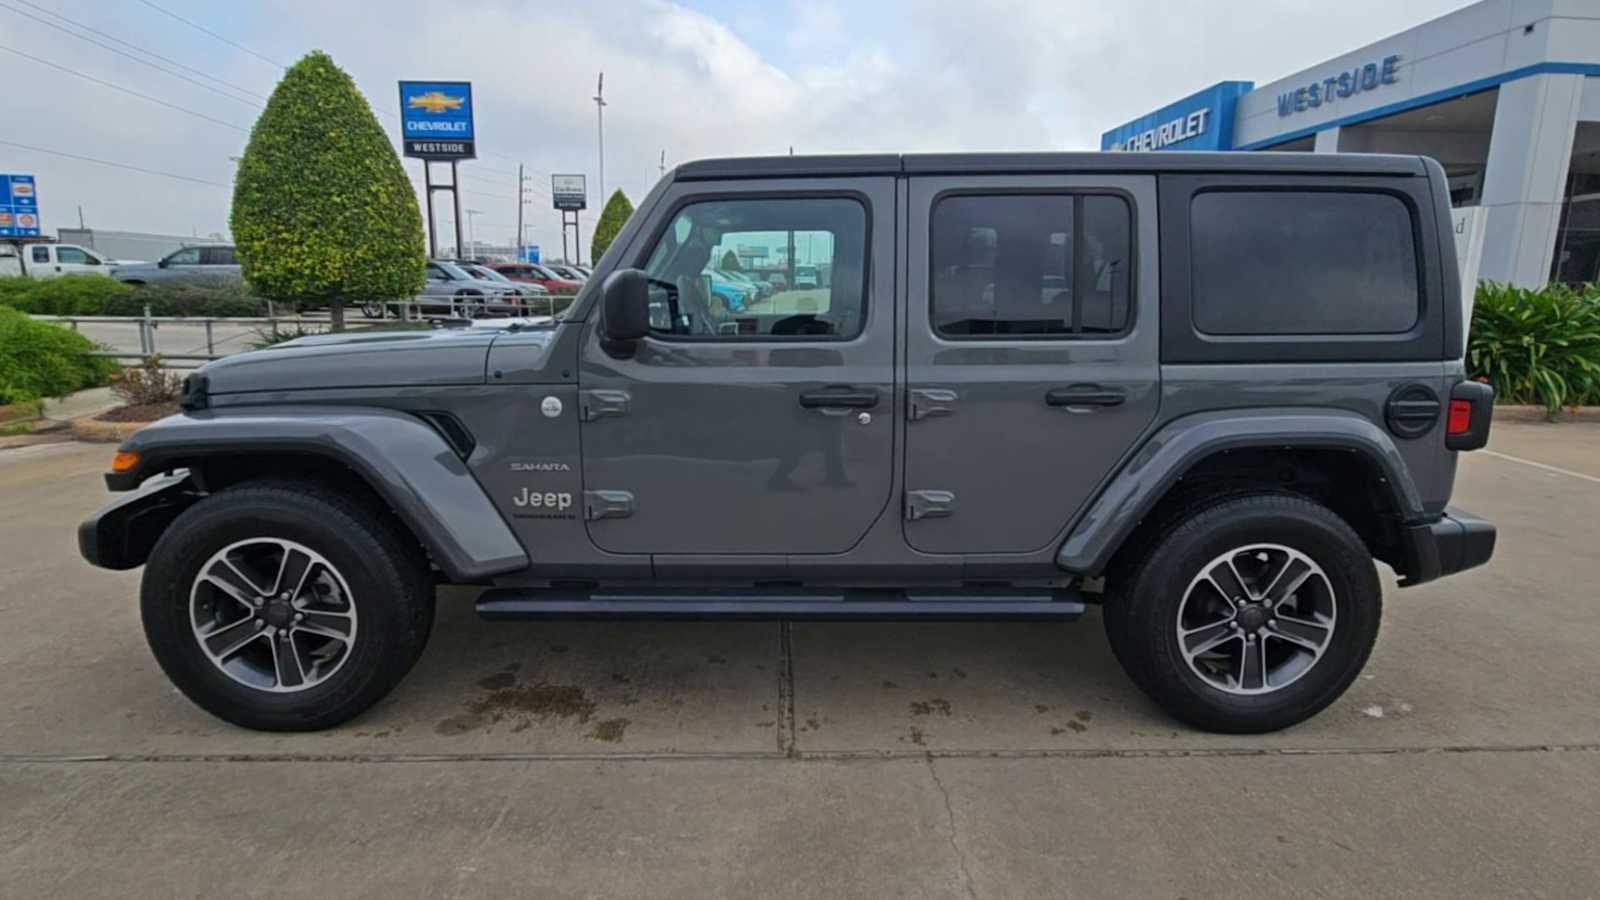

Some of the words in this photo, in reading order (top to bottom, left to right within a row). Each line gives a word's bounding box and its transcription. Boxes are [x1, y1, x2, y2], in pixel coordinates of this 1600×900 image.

[1277, 54, 1401, 117] WESTSIDE
[407, 121, 467, 131] CHEVROLET
[1126, 107, 1211, 152] CHEVROLET
[413, 143, 464, 152] WESTSIDE
[510, 463, 571, 471] SAHARA
[512, 487, 572, 511] Jeep
